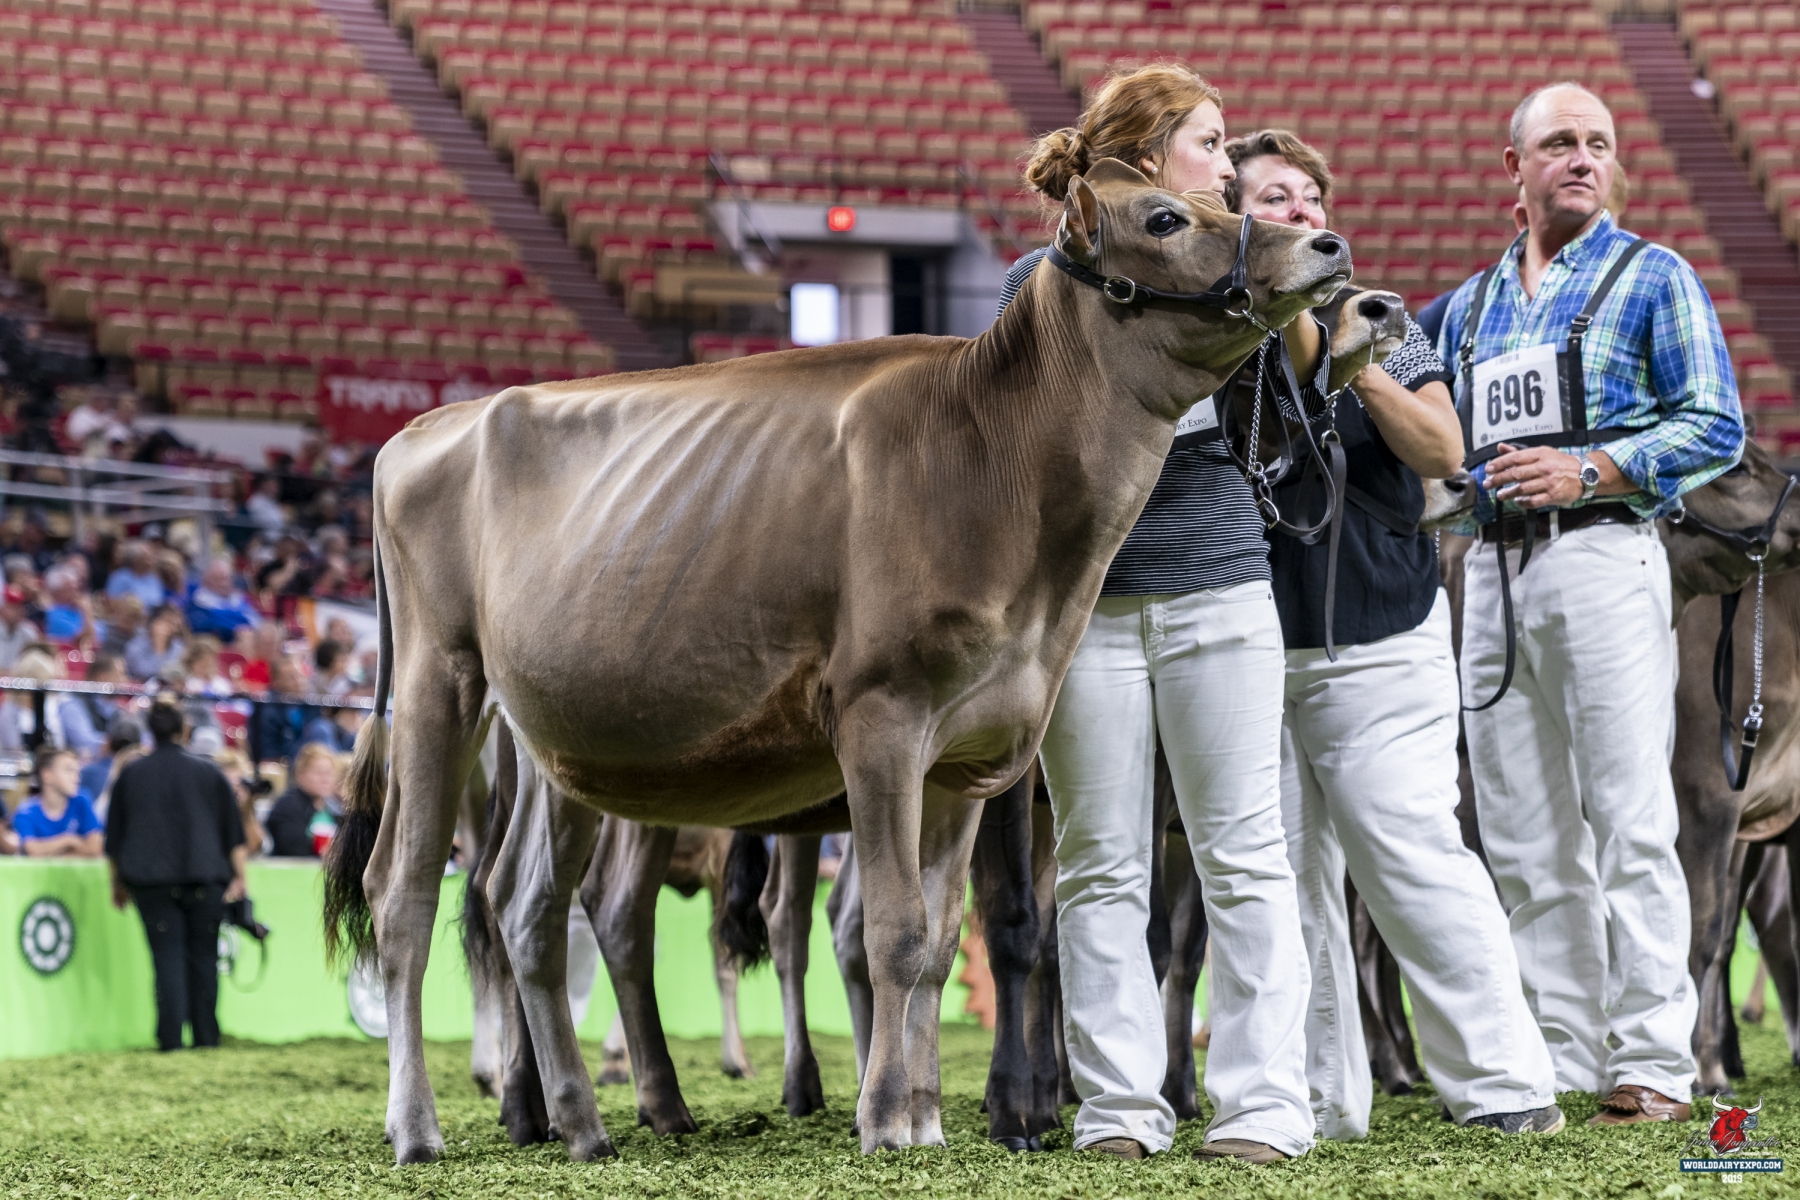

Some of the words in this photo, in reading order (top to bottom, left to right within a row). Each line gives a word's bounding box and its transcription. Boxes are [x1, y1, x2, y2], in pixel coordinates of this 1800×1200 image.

[1487, 370, 1543, 426] 696
[1512, 427, 1532, 436] DAIRY
[1534, 424, 1553, 432] EXPO
